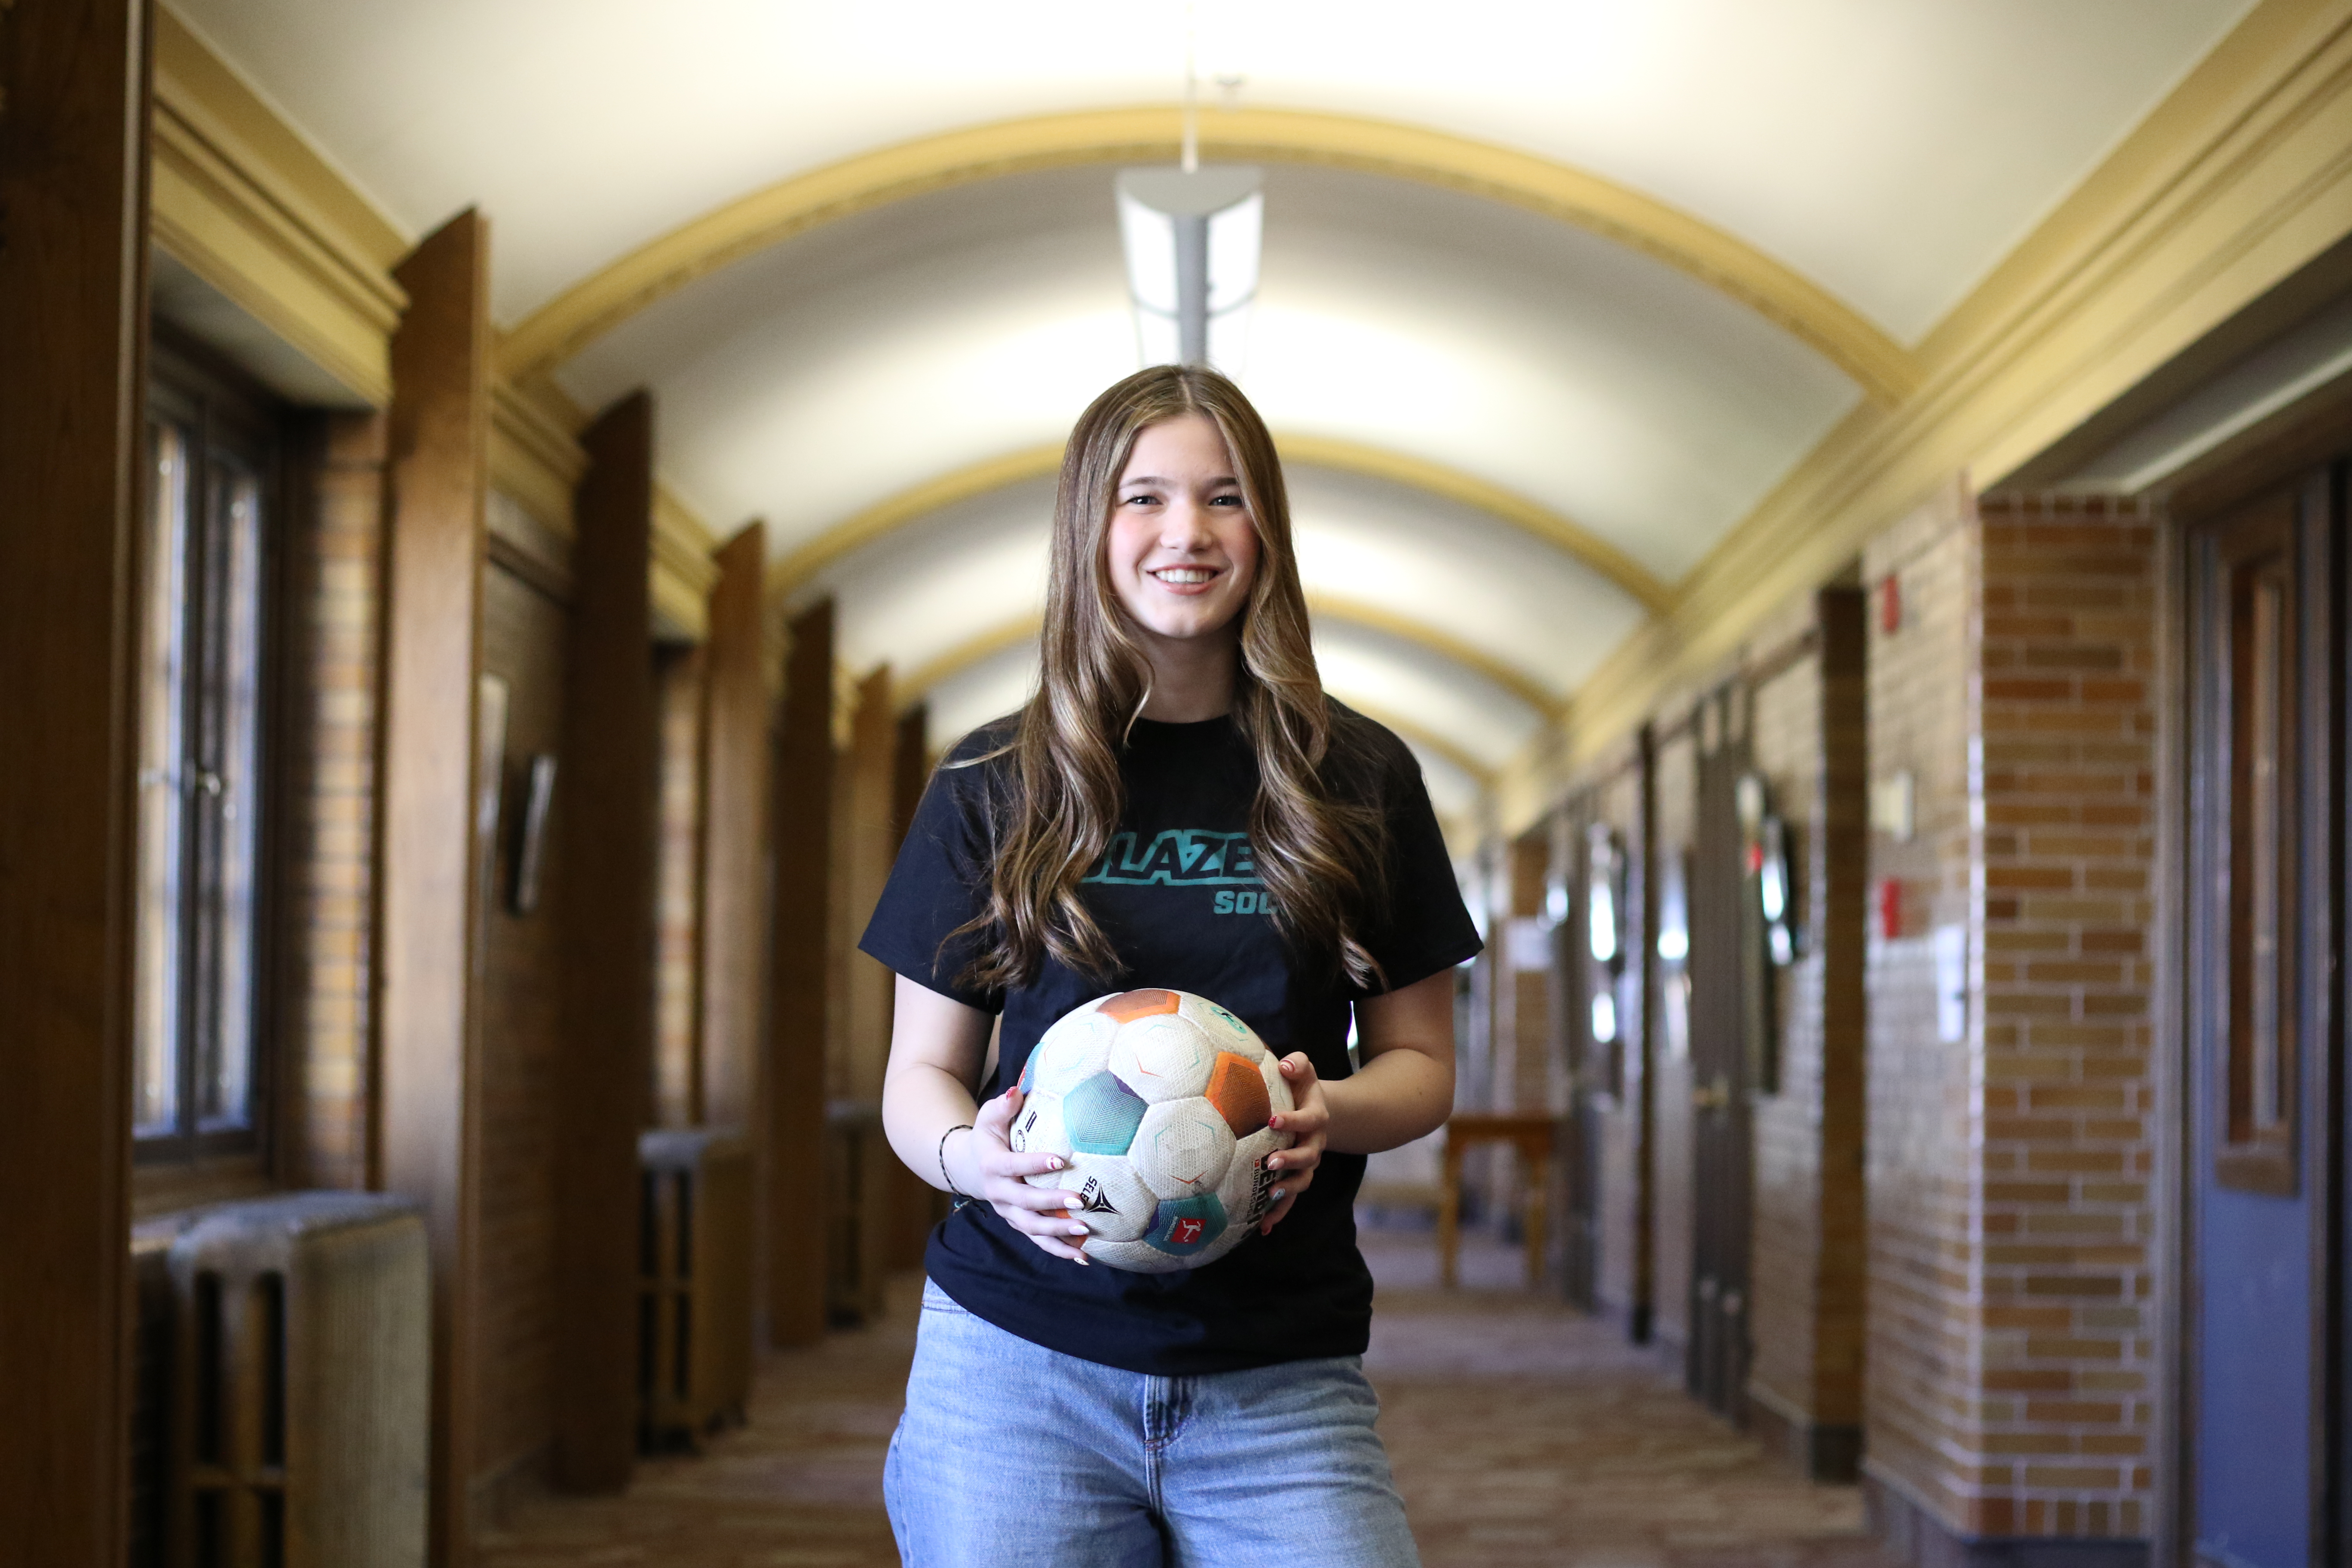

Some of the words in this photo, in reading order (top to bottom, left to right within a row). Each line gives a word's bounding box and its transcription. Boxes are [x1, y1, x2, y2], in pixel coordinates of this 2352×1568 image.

[1080, 829, 1266, 886] LAZE
[1213, 891, 1279, 914] SOC
[1080, 1176, 1097, 1210] SELE
